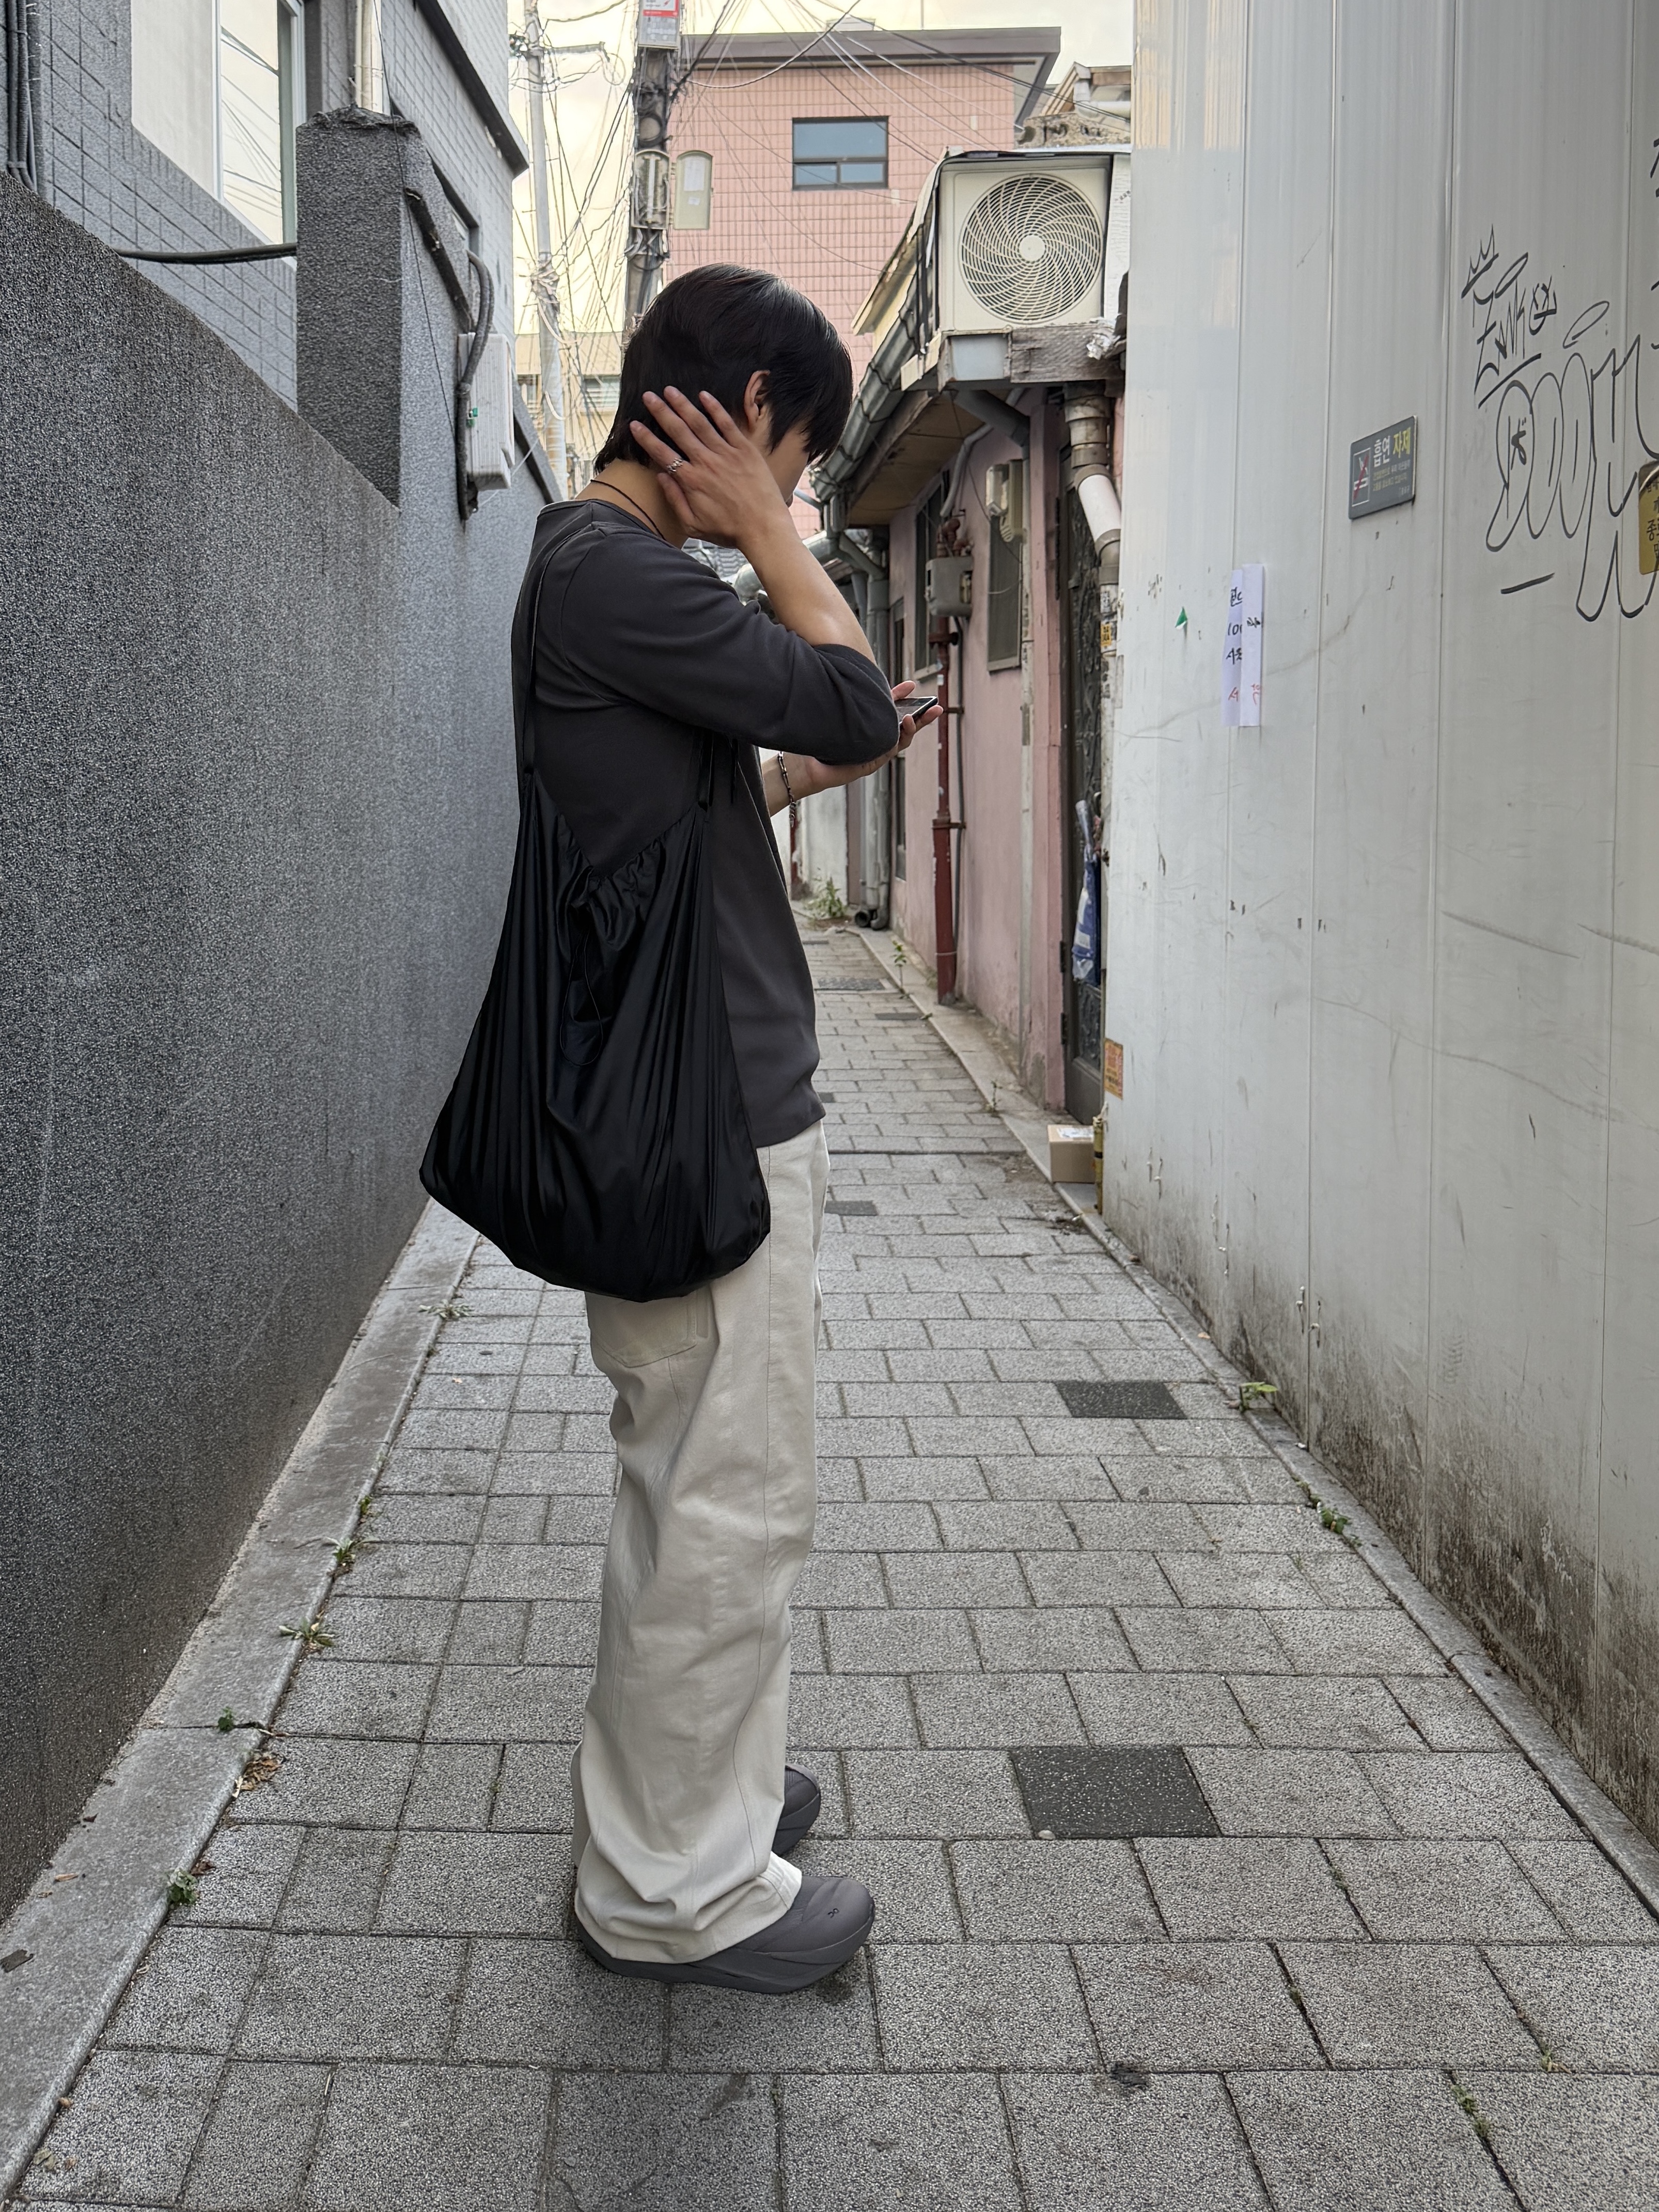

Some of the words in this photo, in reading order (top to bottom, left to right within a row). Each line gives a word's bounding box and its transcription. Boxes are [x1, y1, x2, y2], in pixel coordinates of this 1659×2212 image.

[1374, 436, 1390, 467] 흡연
[1393, 427, 1411, 458] 자제
[1647, 518, 1659, 541] 종
